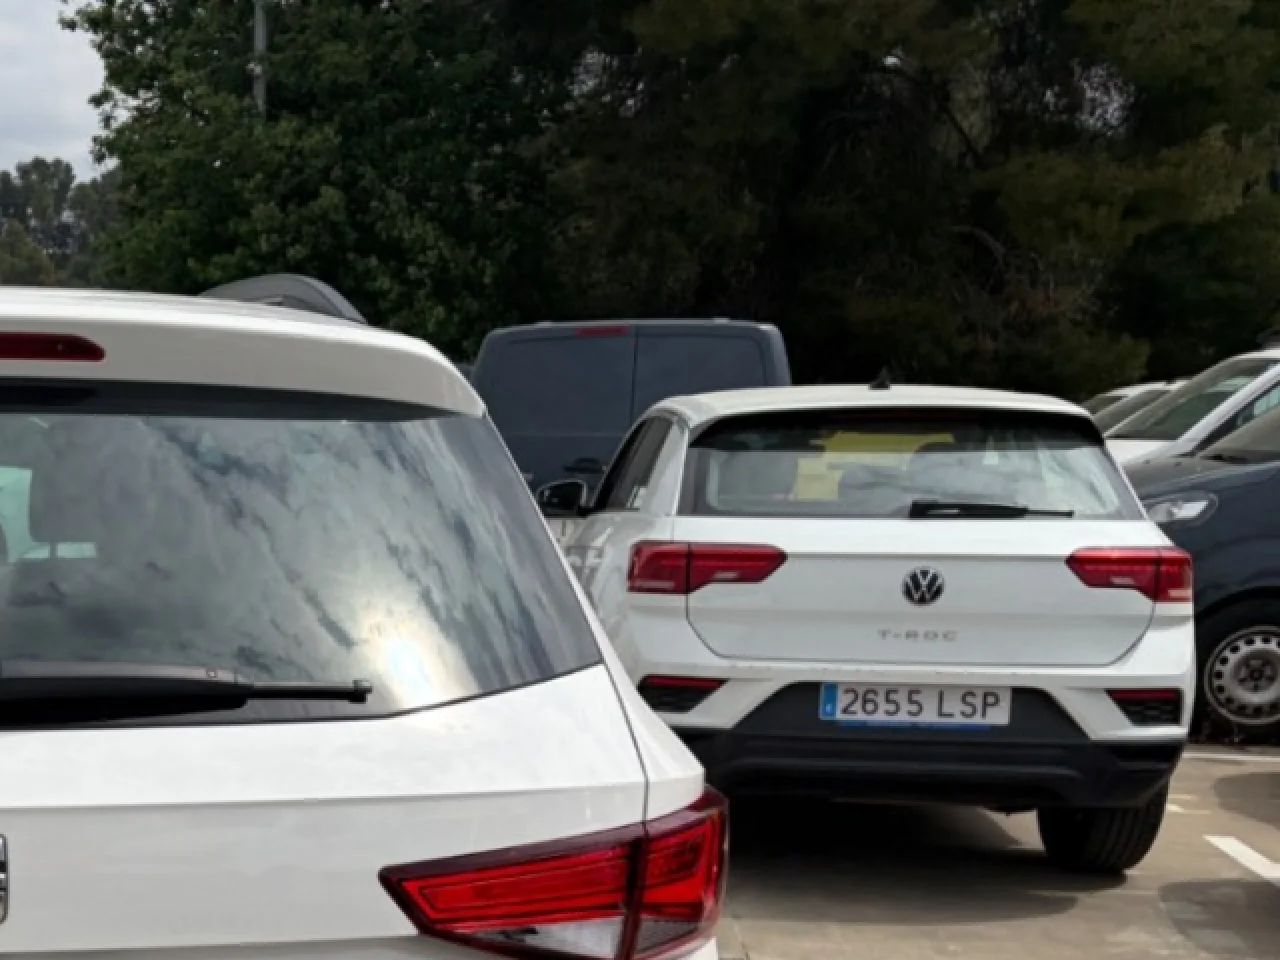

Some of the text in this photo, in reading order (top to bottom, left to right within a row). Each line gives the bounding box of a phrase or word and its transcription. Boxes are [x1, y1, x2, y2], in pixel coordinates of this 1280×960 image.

[878, 629, 957, 641] T-ROC
[840, 687, 924, 717] 2655
[936, 689, 1001, 720] LSP
